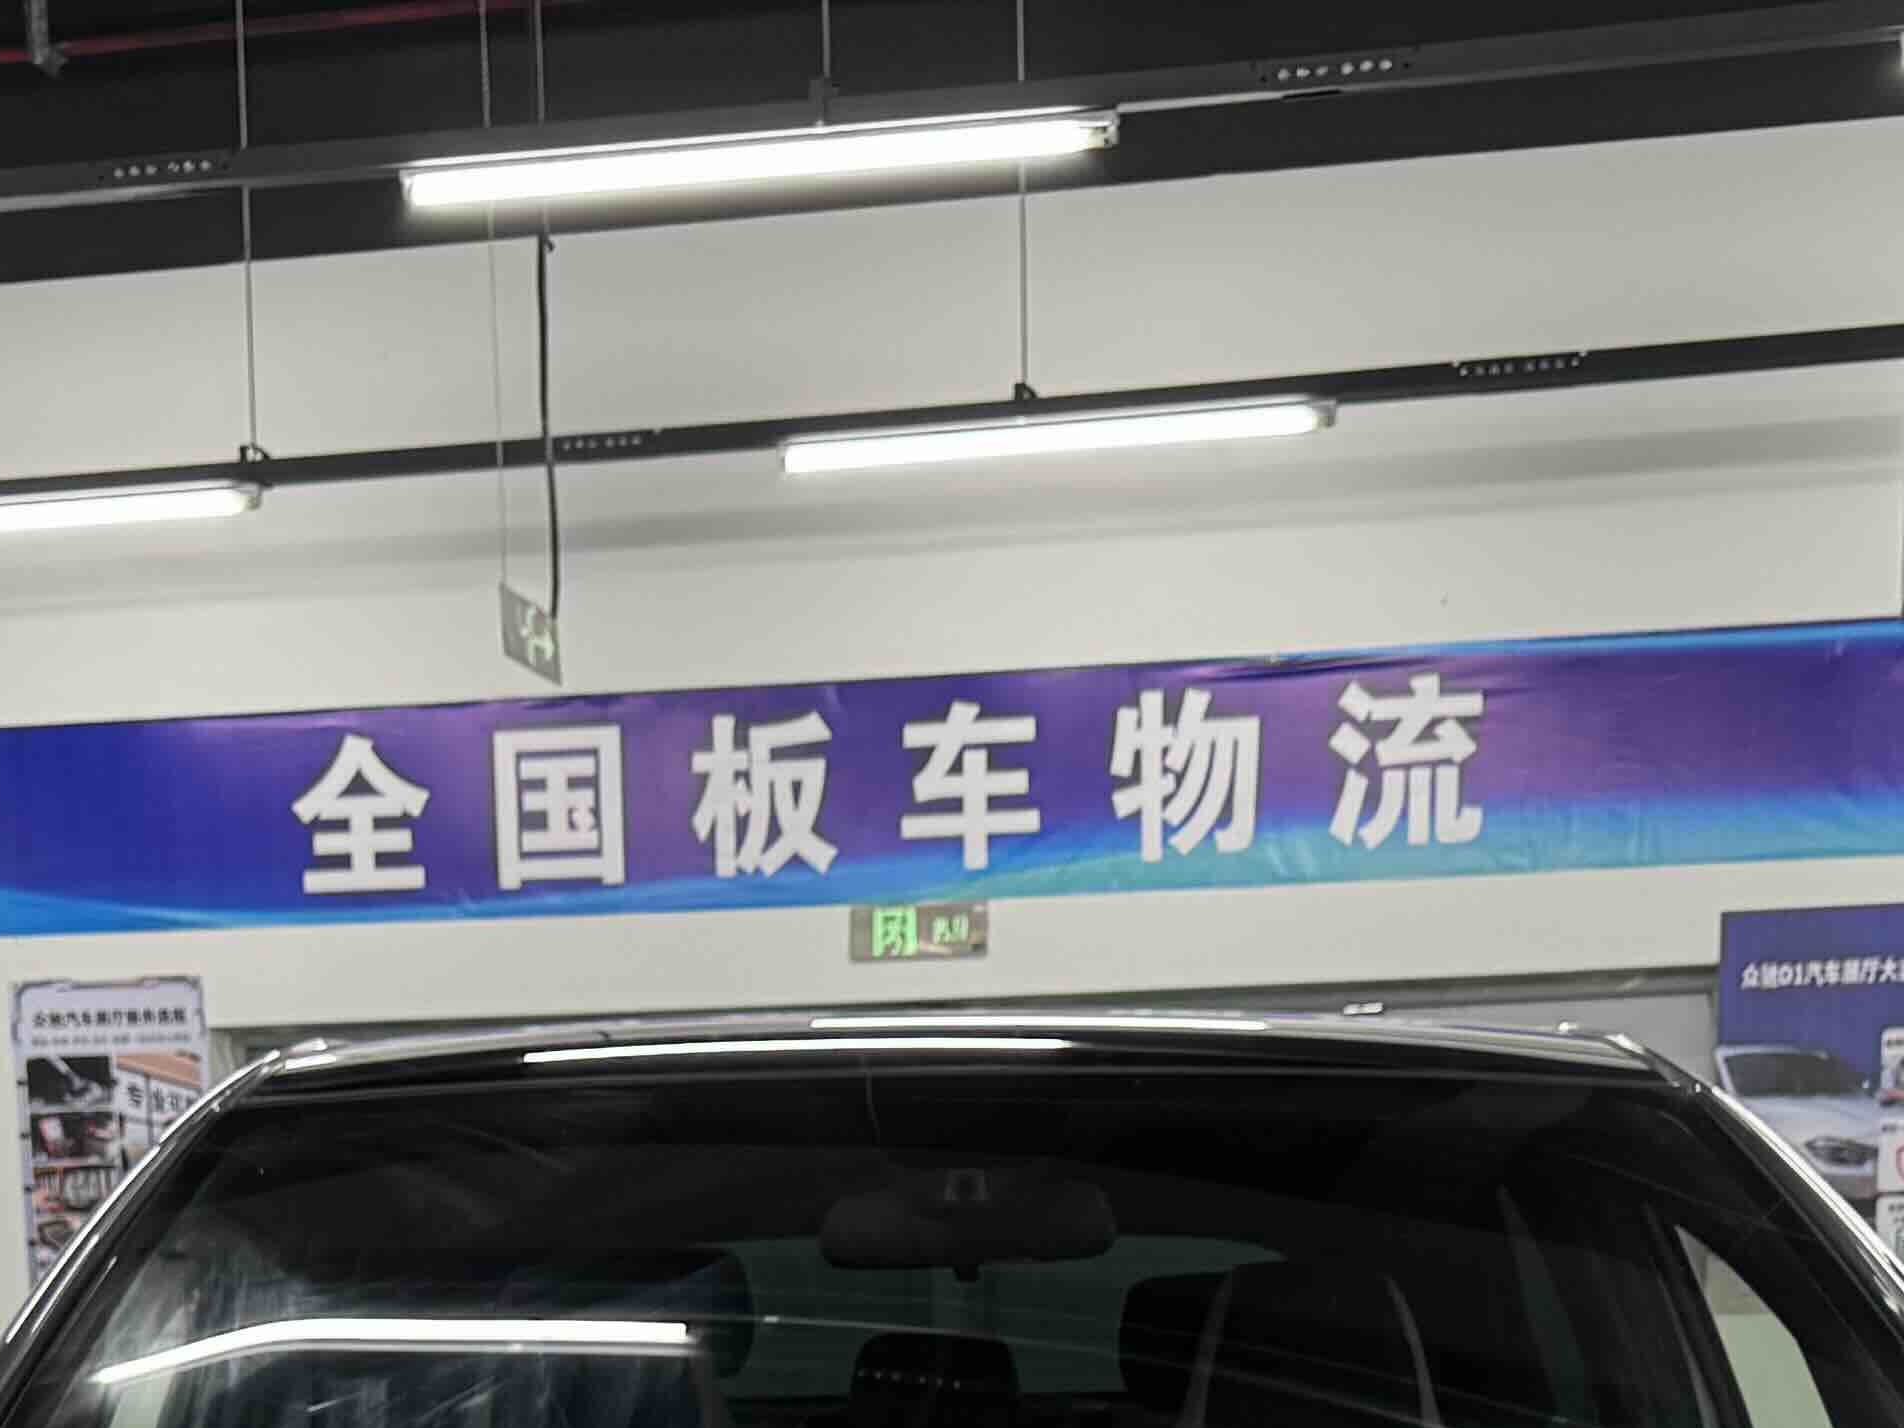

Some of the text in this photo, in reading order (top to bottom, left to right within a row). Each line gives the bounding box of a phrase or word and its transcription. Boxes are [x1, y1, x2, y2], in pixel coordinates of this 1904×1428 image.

[292, 672, 1486, 895] 全国板车物流
